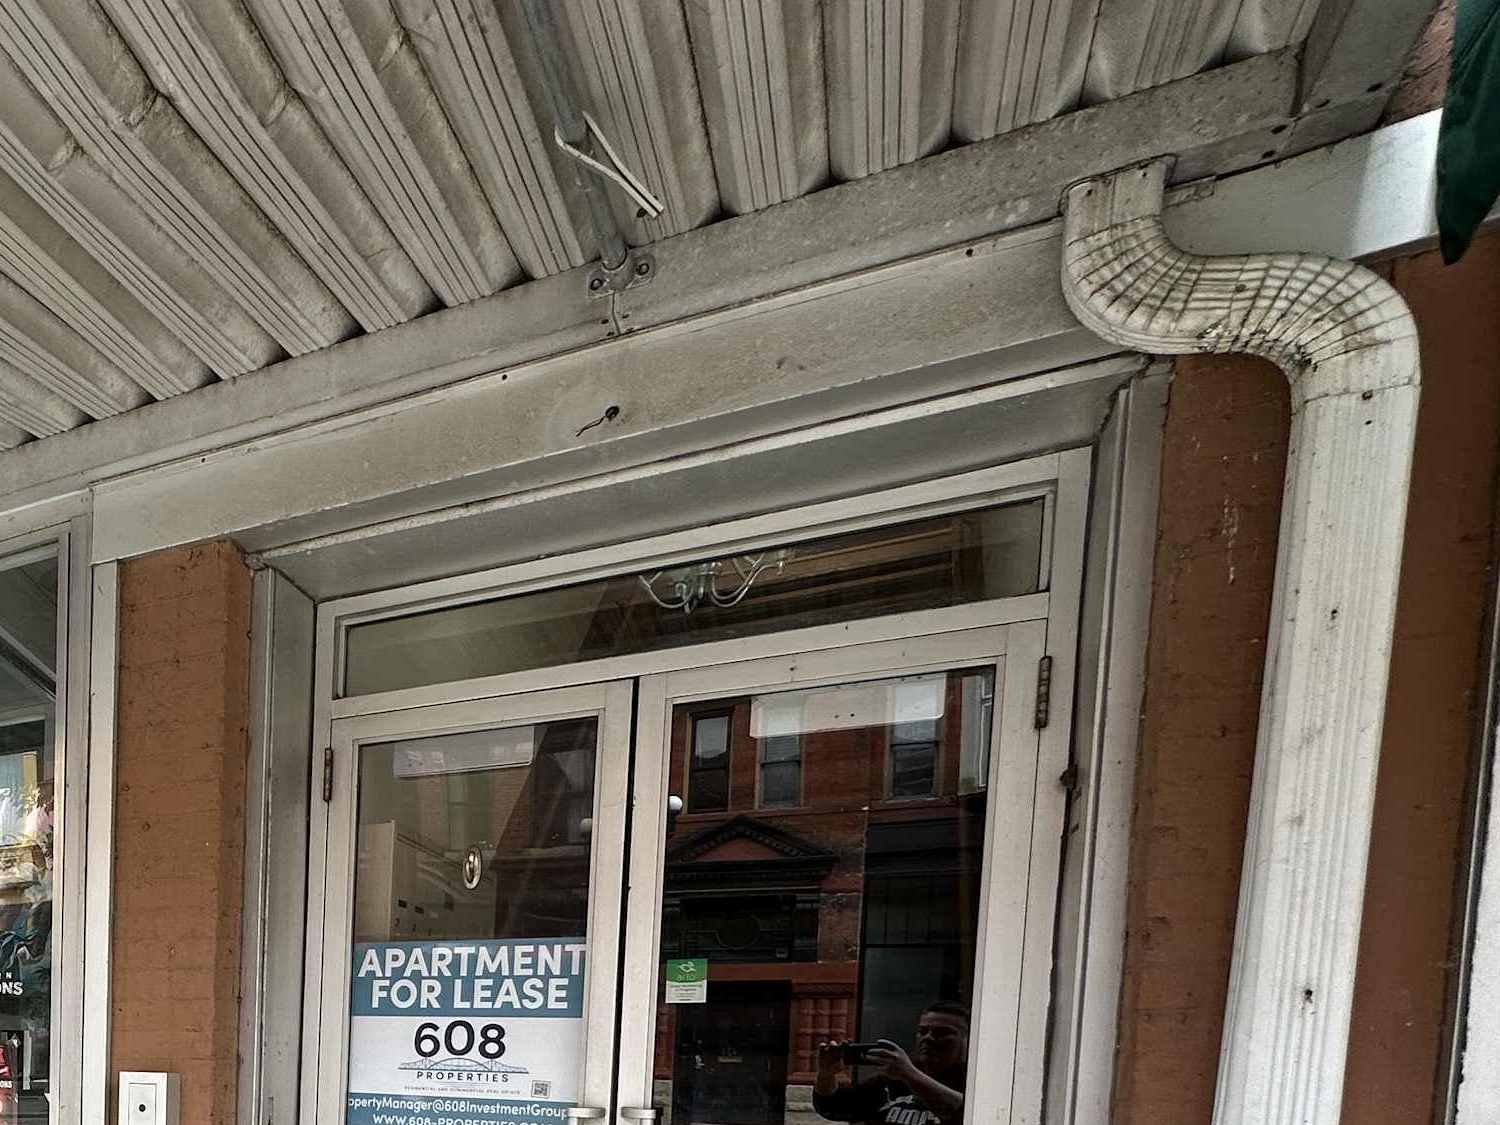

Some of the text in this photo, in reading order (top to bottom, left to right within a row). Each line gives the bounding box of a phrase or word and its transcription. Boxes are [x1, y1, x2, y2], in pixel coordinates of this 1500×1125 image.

[358, 944, 587, 978] APARTMENT
[371, 978, 569, 1009] FOR LEASE
[414, 1019, 506, 1059] 608
[416, 1071, 509, 1082] PROPERTIES
